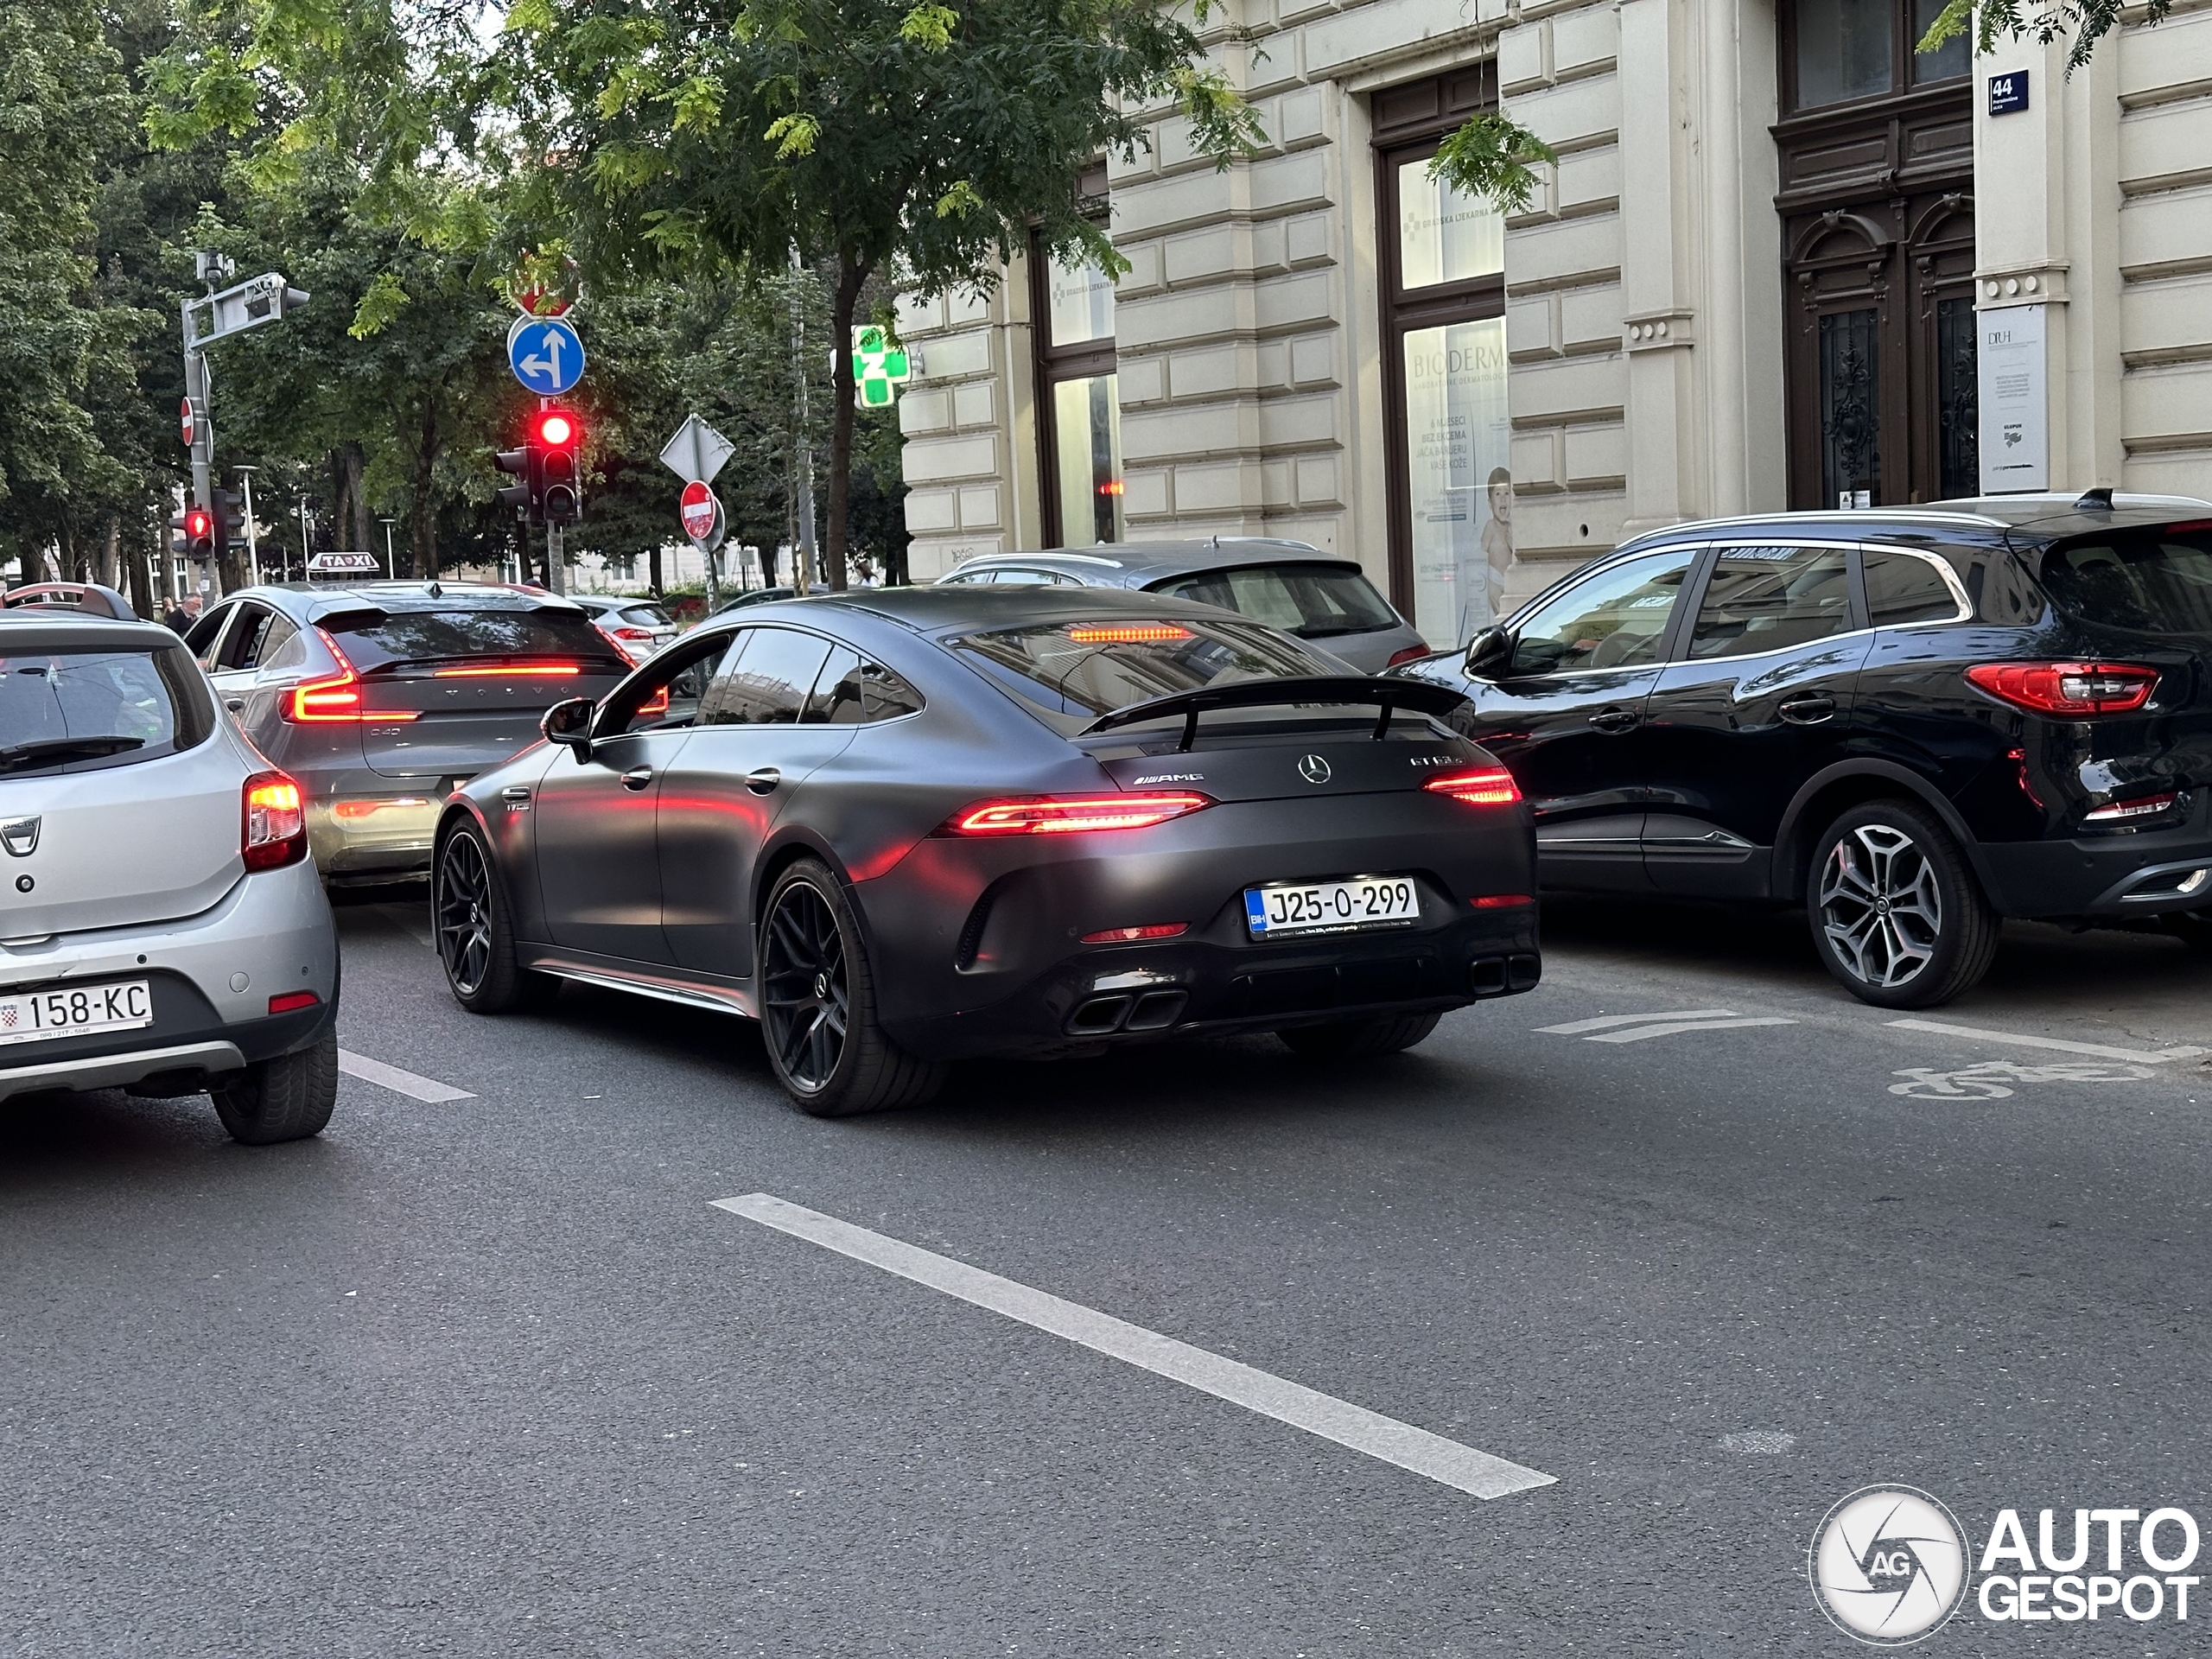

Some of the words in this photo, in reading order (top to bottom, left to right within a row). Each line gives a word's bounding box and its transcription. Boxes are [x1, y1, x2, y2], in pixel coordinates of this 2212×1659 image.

[1993, 79, 2013, 97] 44
[1422, 216, 1453, 228] GRADSKA
[1456, 209, 1489, 222] LJEKARNA
[1421, 433, 1435, 443] BEZ
[322, 555, 372, 567] TAXI
[445, 686, 569, 696] VOLVO
[1151, 774, 1205, 784] AMG
[1270, 883, 1410, 924] J25-O-299
[1250, 914, 1266, 925] BIH
[30, 986, 147, 1027] 158-KC
